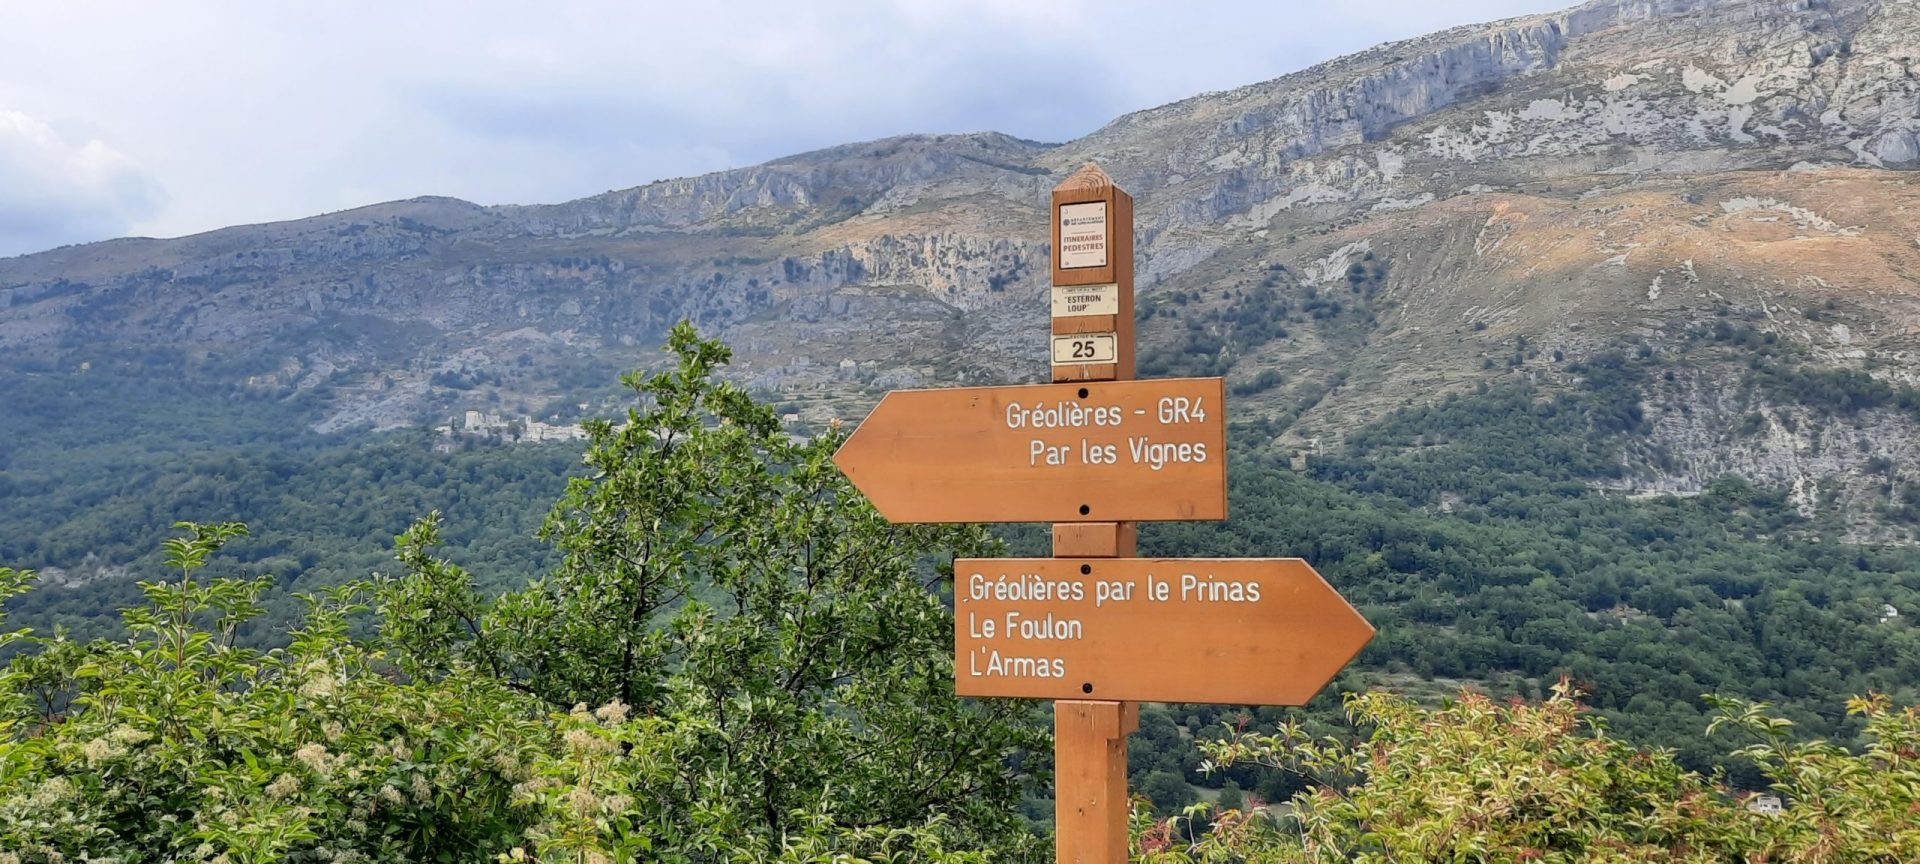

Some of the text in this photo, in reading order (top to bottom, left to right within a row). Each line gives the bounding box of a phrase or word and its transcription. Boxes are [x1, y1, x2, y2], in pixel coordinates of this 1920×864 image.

[1072, 341, 1095, 358] 25
[1006, 401, 1122, 428] Gréolières
[1158, 397, 1206, 424] GR4
[1030, 436, 1207, 471] Par les Vignes
[969, 573, 1260, 607] Gréolières par le Prinas
[970, 612, 1083, 640] Le Foulon
[970, 645, 1065, 678] L'Armas
